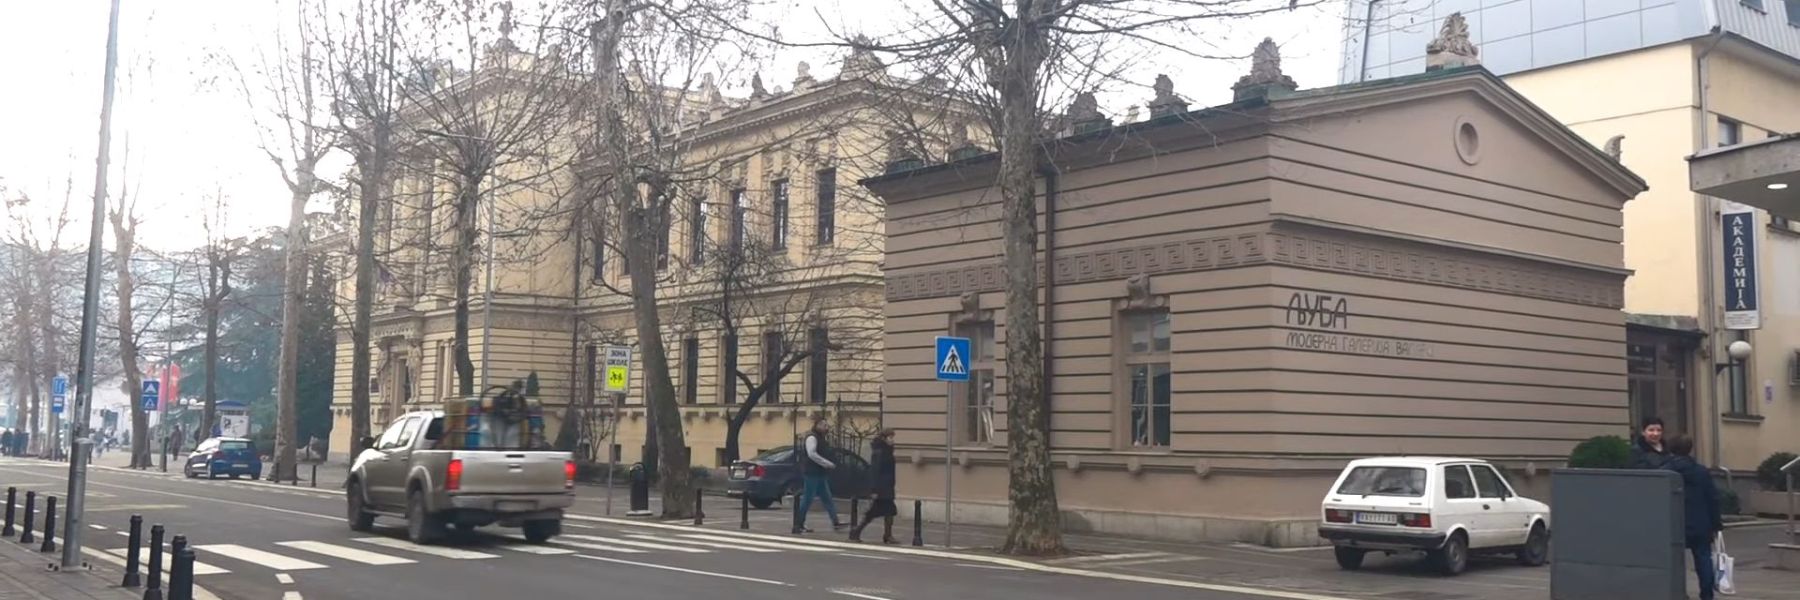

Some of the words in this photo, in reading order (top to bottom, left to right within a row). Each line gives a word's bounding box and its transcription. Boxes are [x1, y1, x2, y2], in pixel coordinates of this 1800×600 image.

[1732, 215, 1747, 310] АКАДЕМИЈА
[1286, 292, 1348, 330] ЉУБА
[1286, 331, 1338, 351] МОДЕРНА
